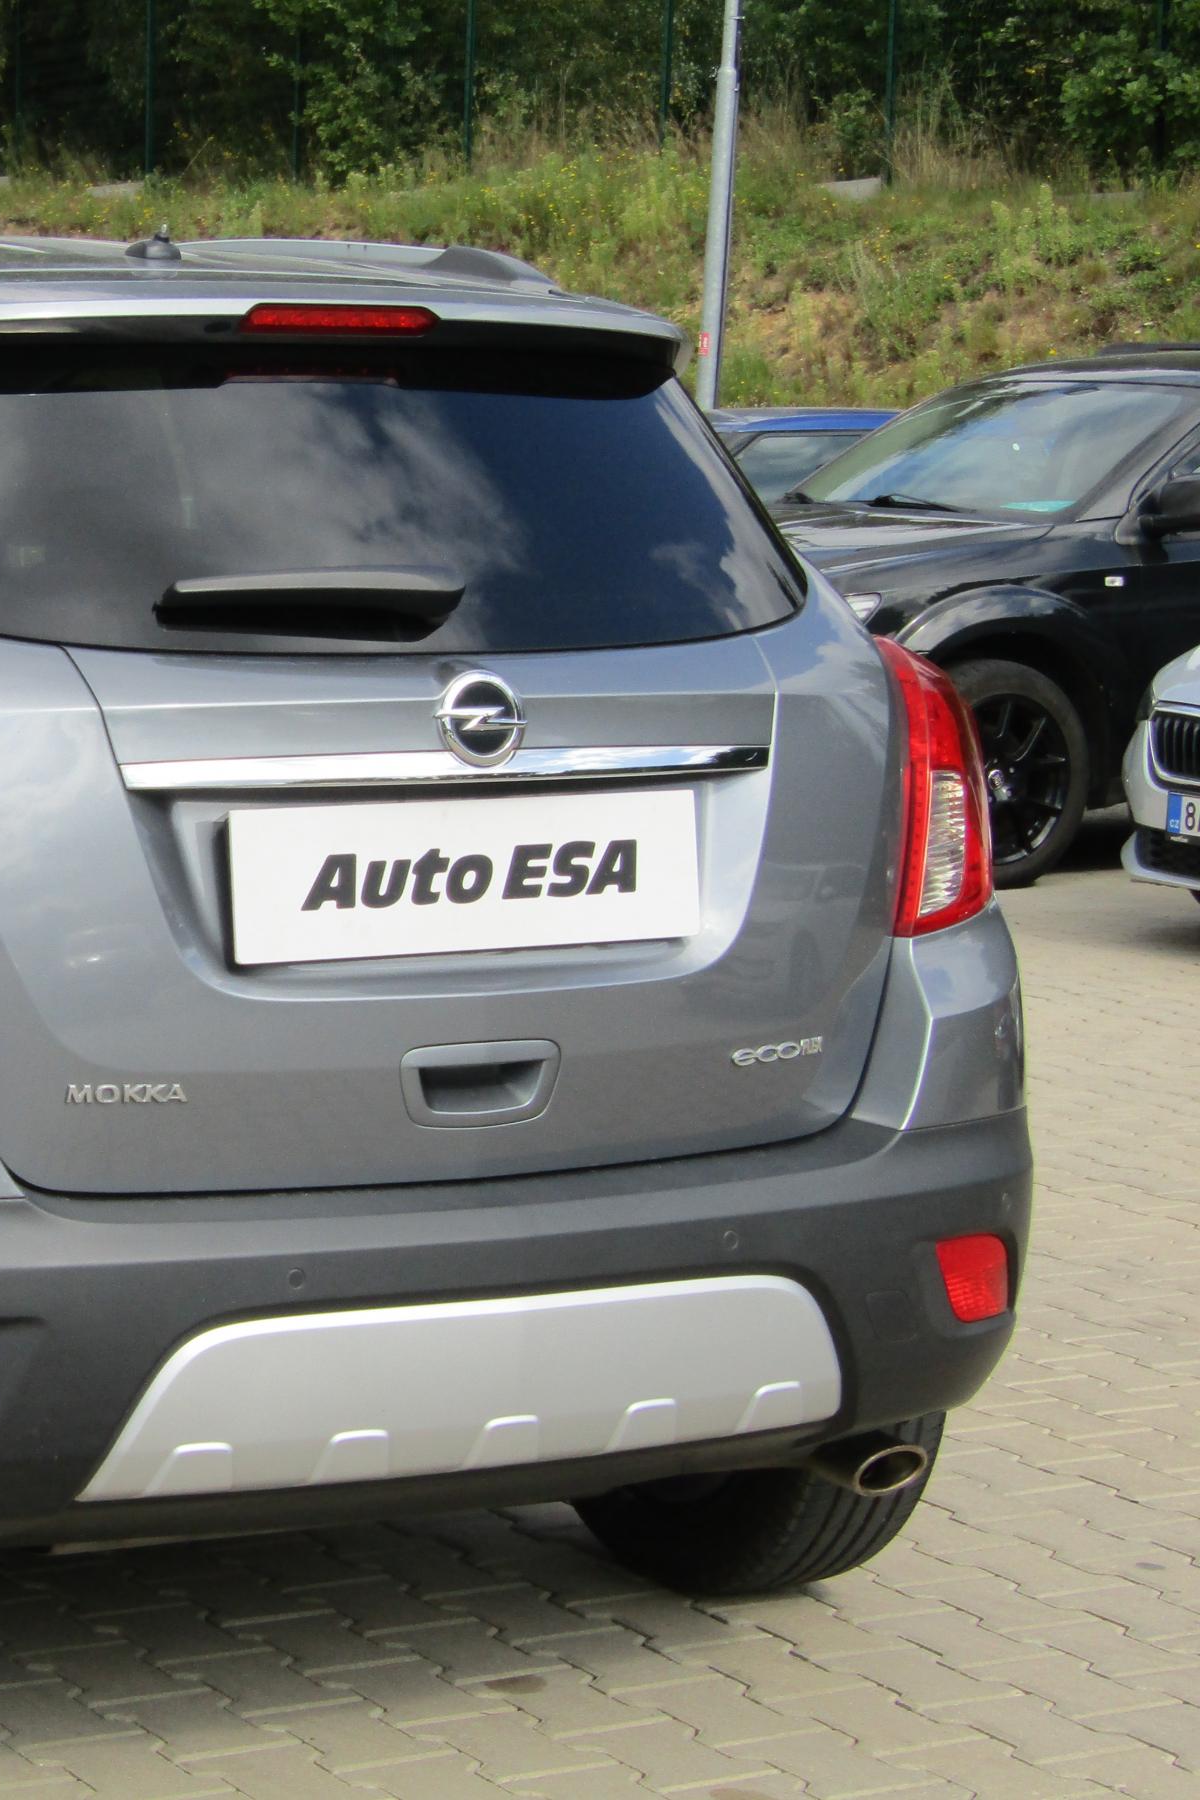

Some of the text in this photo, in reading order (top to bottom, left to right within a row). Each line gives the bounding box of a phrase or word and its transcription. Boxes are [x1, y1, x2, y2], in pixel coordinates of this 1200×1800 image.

[301, 839, 637, 911] Auto ESA
[65, 1083, 189, 1104] MOKKA
